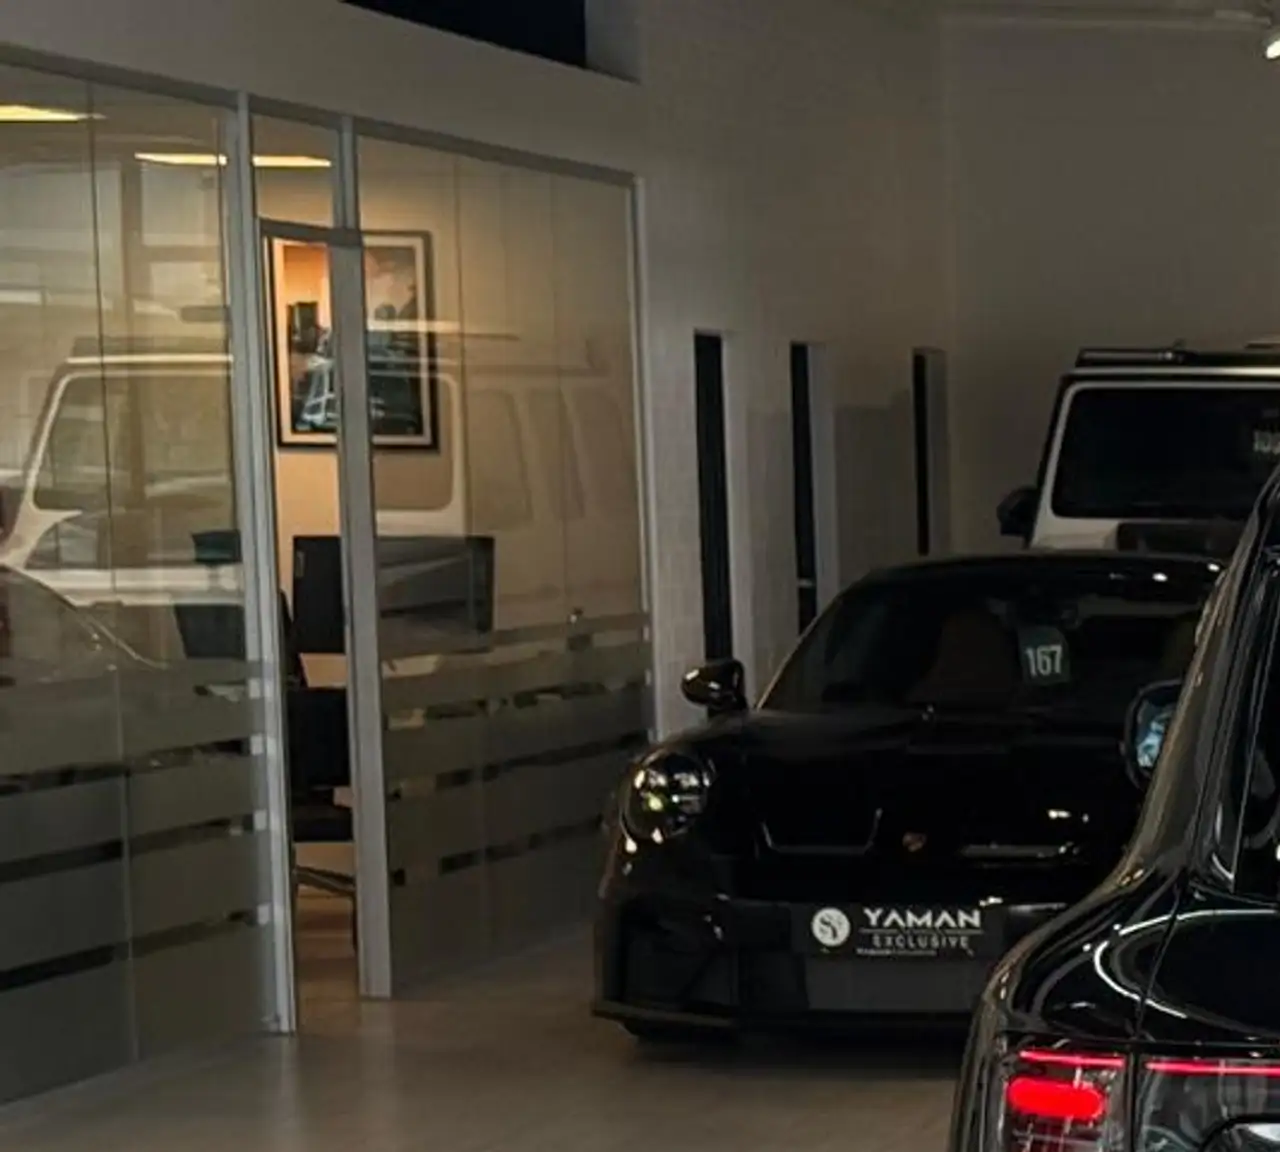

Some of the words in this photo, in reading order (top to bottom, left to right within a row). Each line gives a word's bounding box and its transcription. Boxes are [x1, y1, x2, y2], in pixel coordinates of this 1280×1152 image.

[1025, 644, 1062, 677] 167
[863, 907, 981, 928] YAMAN
[872, 935, 970, 948] EXCLUSIVE
